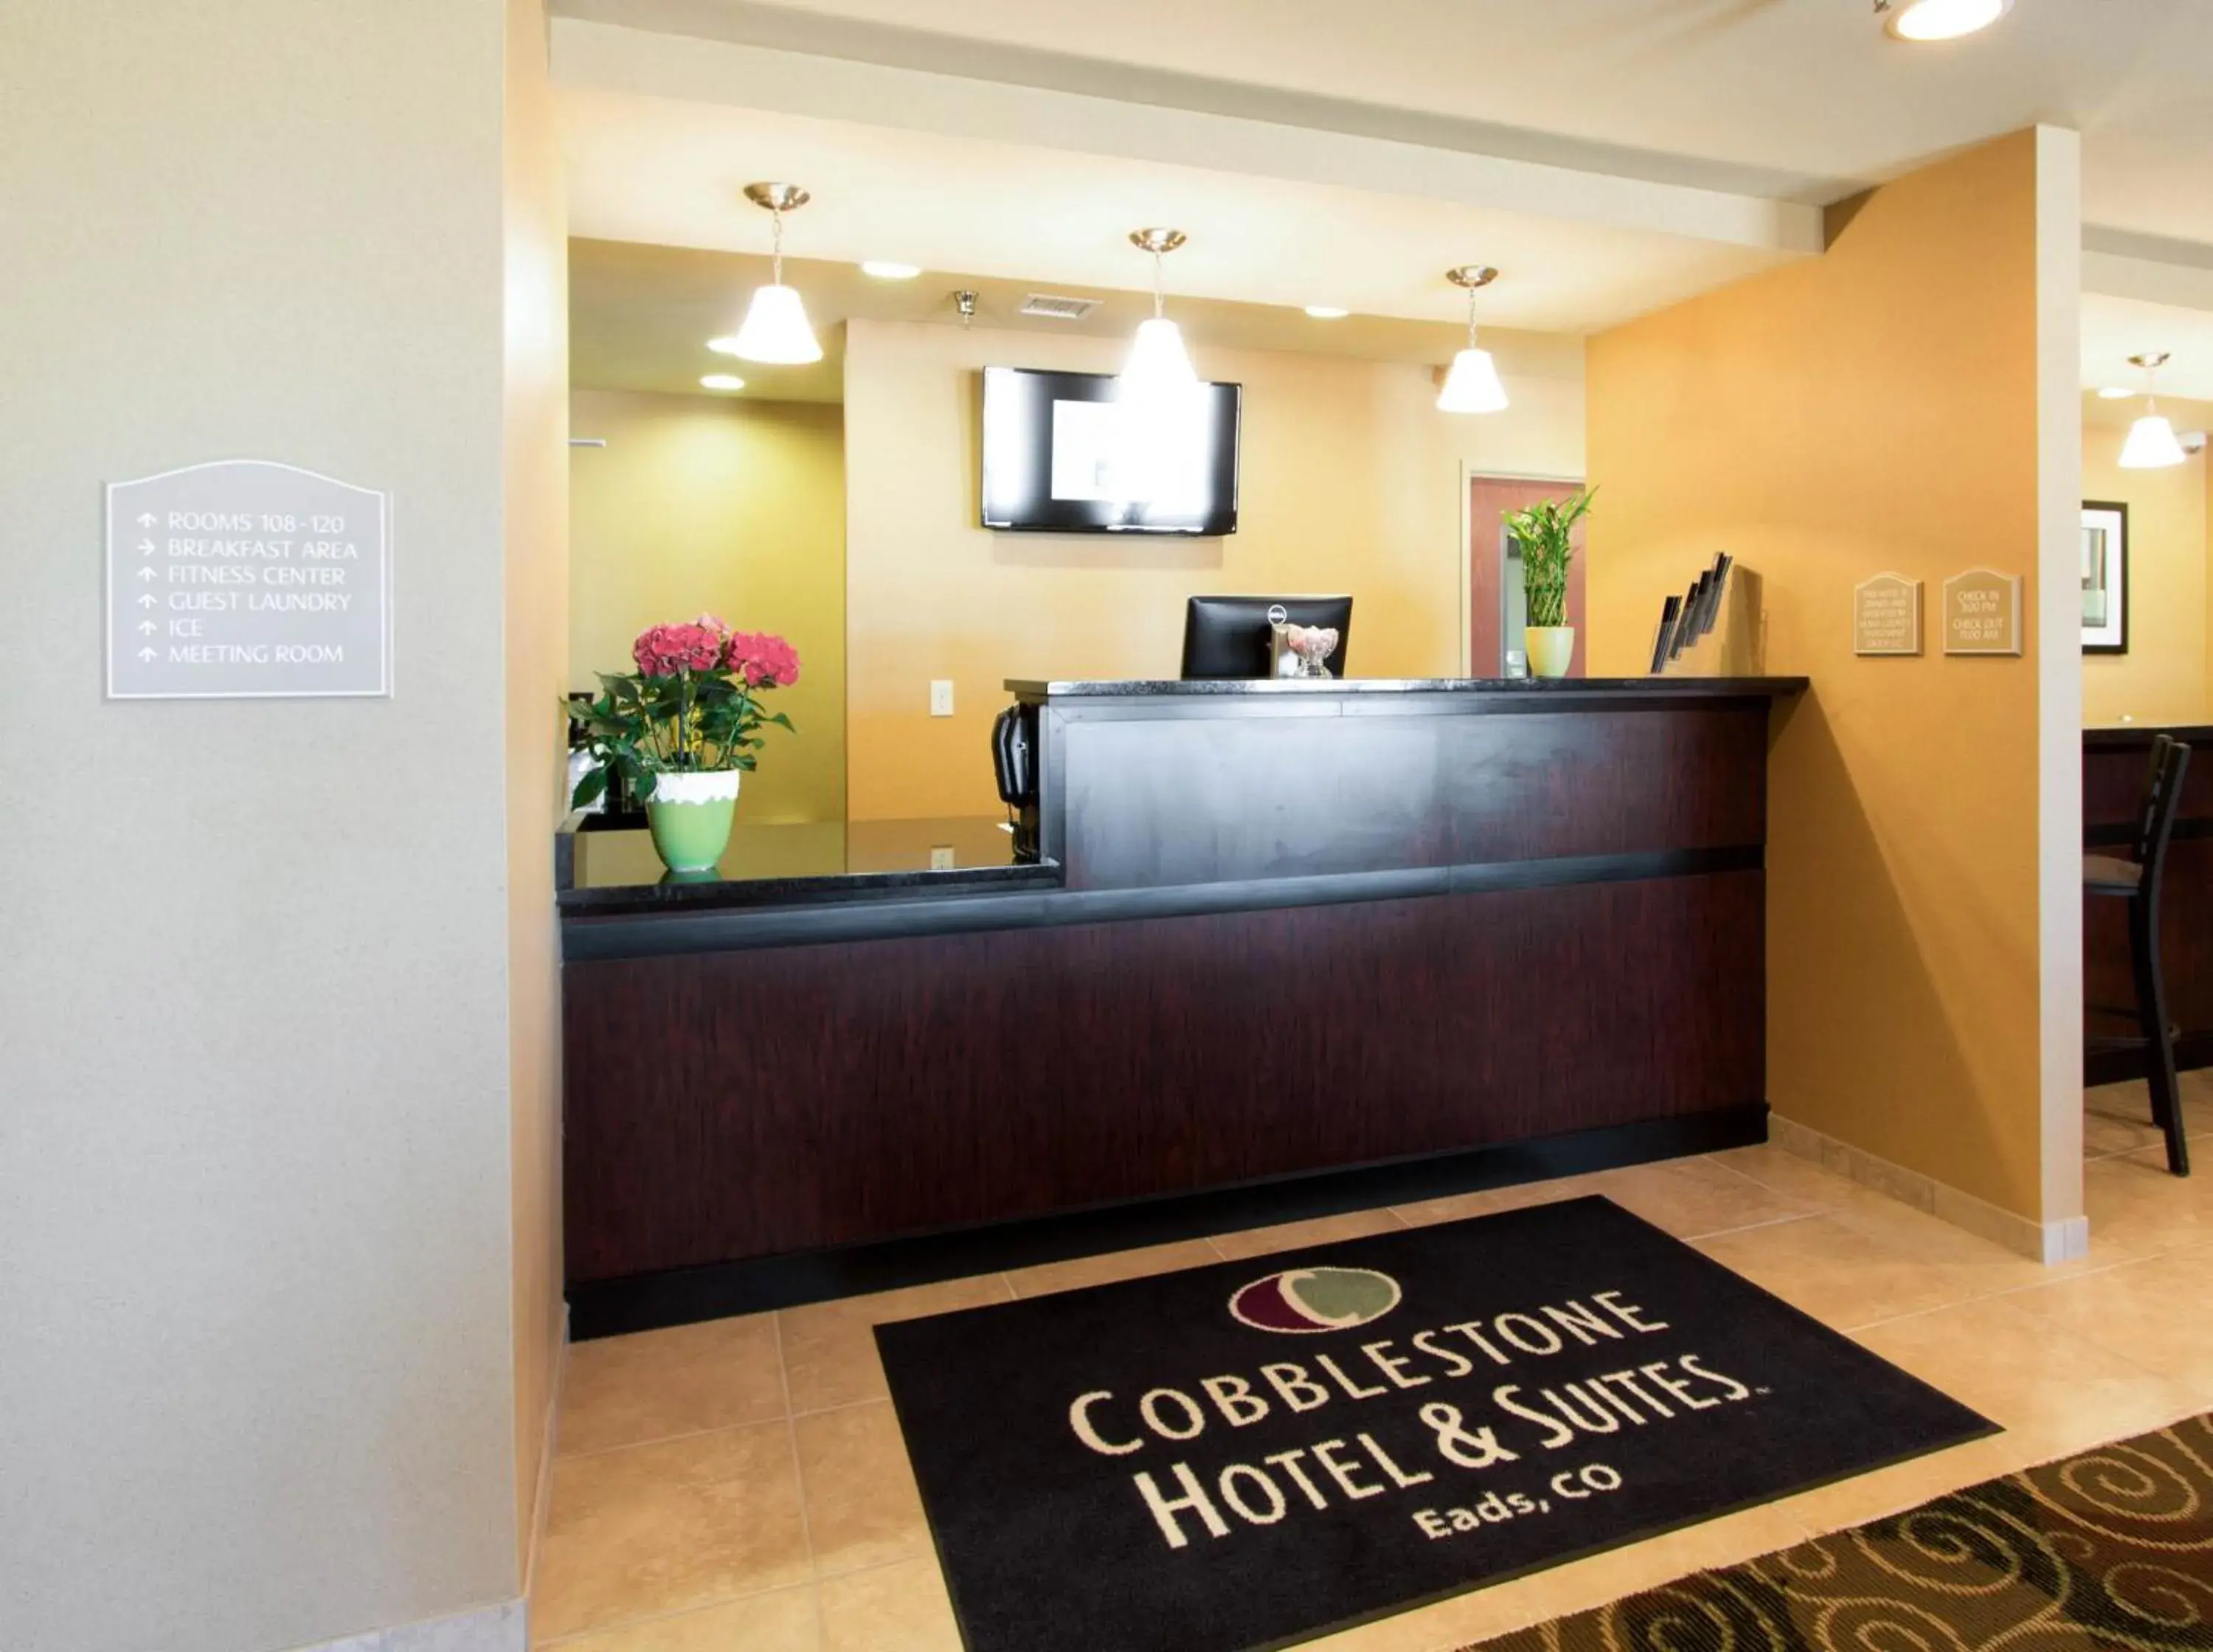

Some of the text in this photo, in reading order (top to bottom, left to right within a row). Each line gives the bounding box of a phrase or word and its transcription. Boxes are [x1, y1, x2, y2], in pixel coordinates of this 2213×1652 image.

[167, 511, 252, 532] ROOMS
[167, 538, 359, 560] BREAKFAST AREA
[167, 564, 346, 586] FITNESS CENTER
[167, 591, 352, 612] GUEST LAUNDRY
[167, 618, 204, 638] ICE
[167, 644, 344, 664] MEETING ROOM
[1070, 1291, 1669, 1455] COBBLESTONE
[1133, 1355, 1750, 1549] HOTEL & SUITES
[1412, 1463, 1622, 1539] Eads, CO
